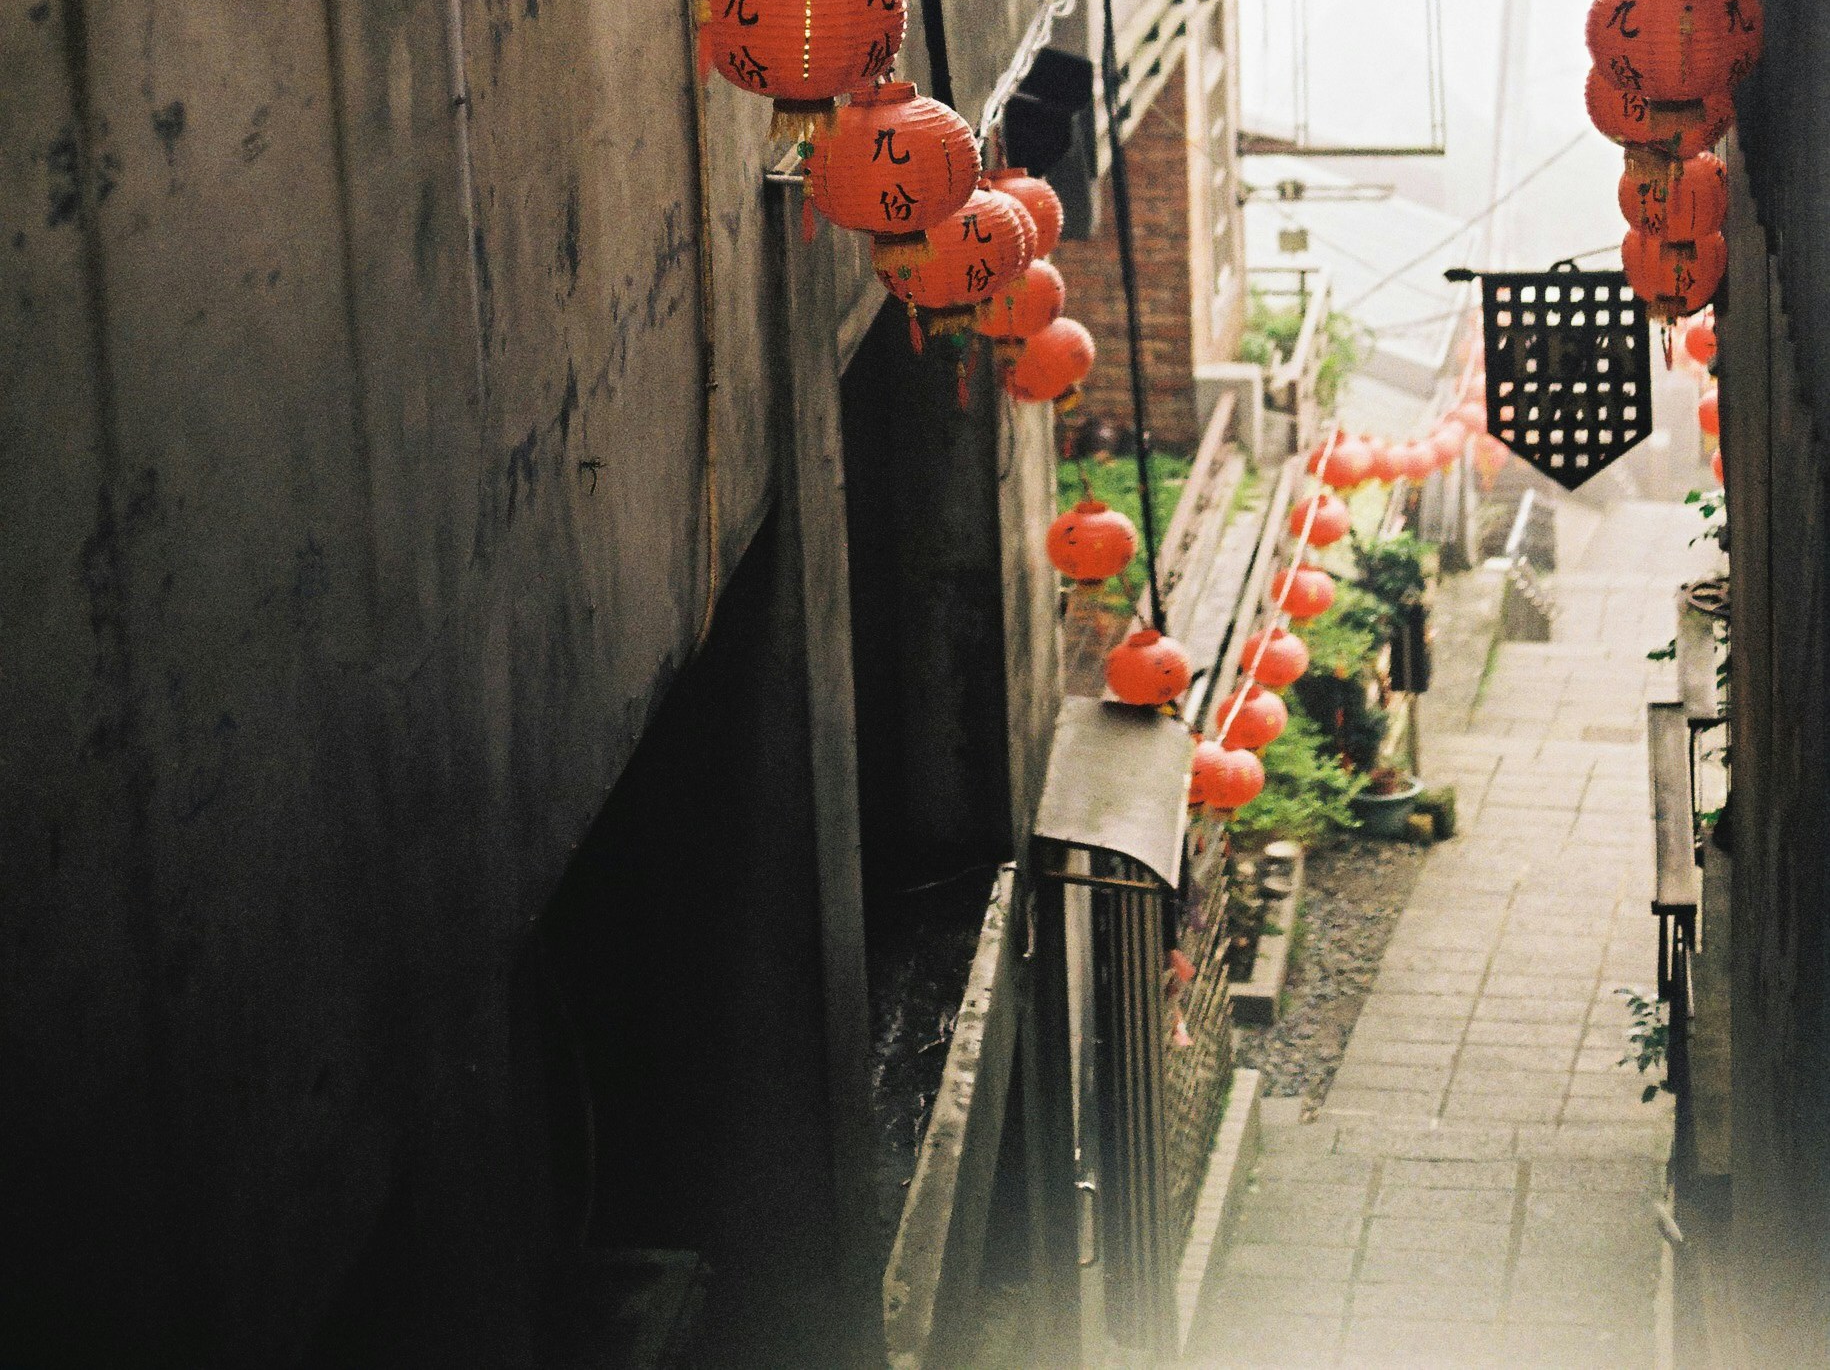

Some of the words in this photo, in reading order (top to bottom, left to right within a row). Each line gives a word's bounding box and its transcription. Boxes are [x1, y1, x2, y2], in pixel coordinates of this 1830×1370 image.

[1606, 0, 1644, 91] 九份
[872, 128, 919, 222] 九份
[961, 214, 996, 293] 九份
